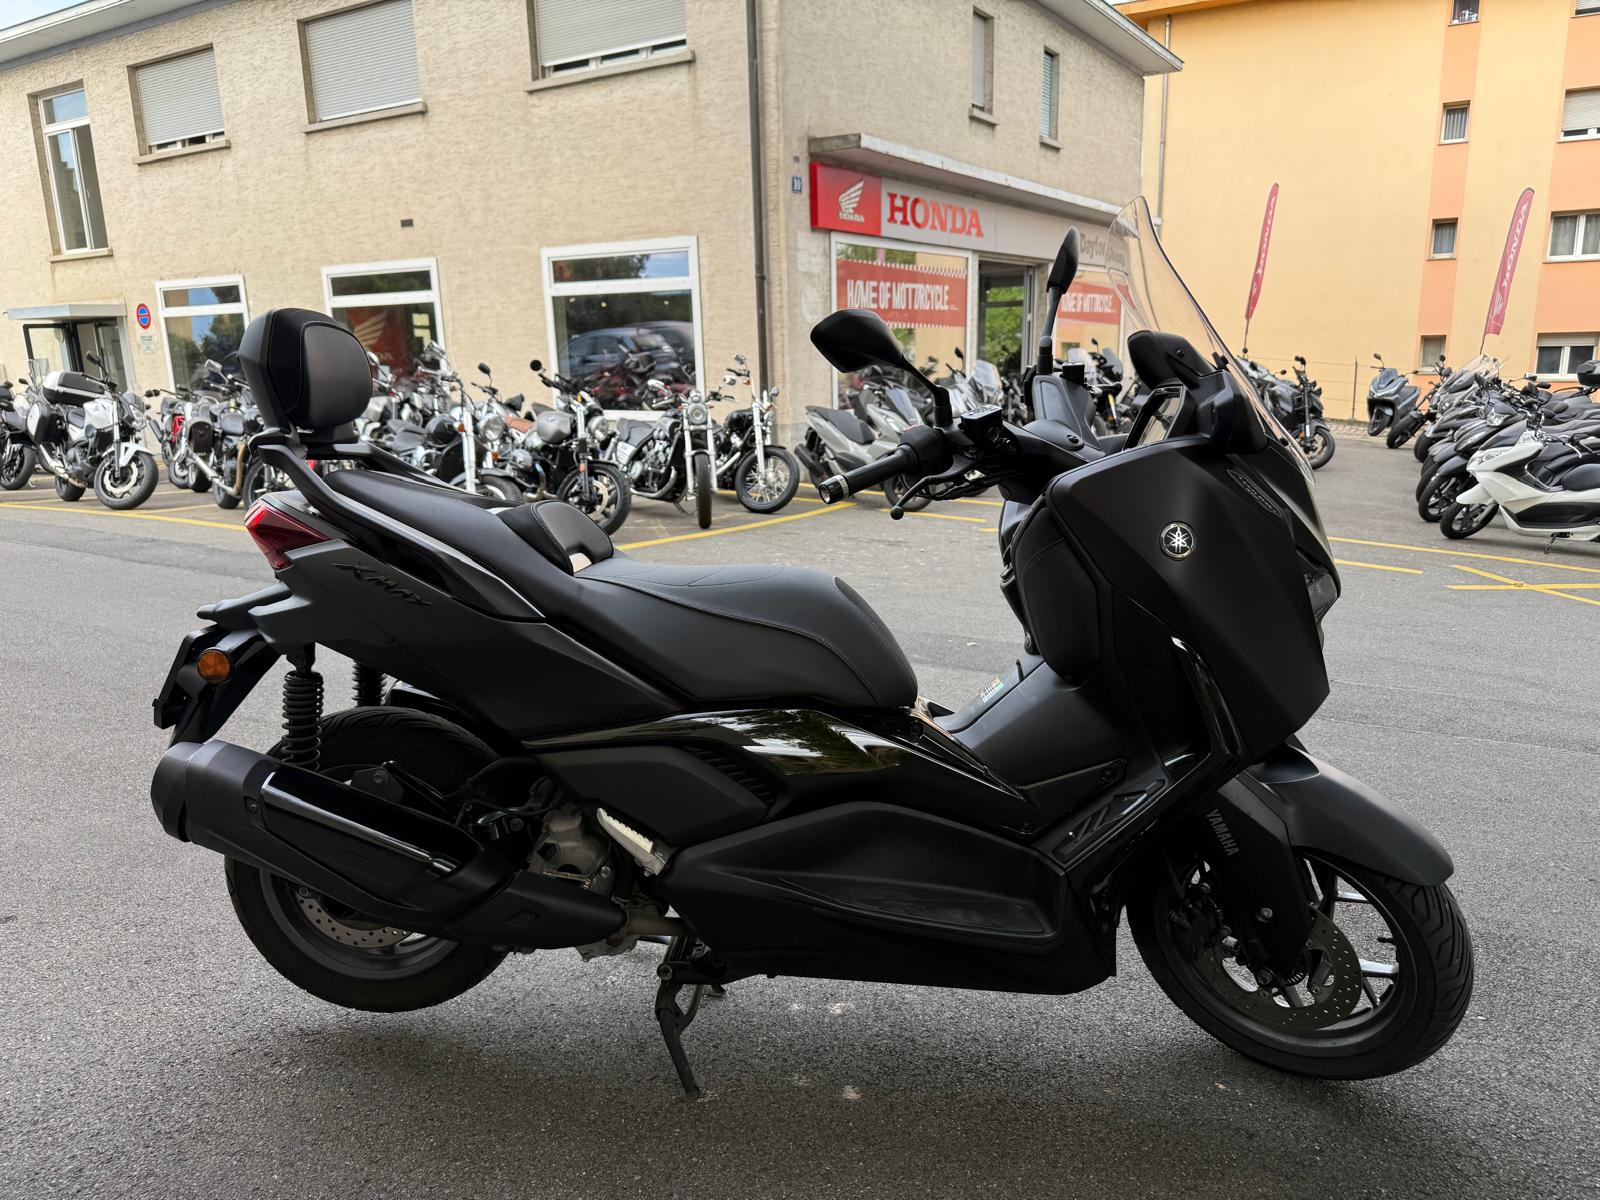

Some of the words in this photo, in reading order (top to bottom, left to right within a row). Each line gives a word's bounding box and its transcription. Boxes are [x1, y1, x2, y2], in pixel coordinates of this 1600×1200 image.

[887, 192, 984, 238] HONDA
[1501, 202, 1528, 288] HONDA
[847, 279, 878, 308] HOME
[879, 281, 891, 310] OF
[1205, 808, 1240, 857] YAMAHA
